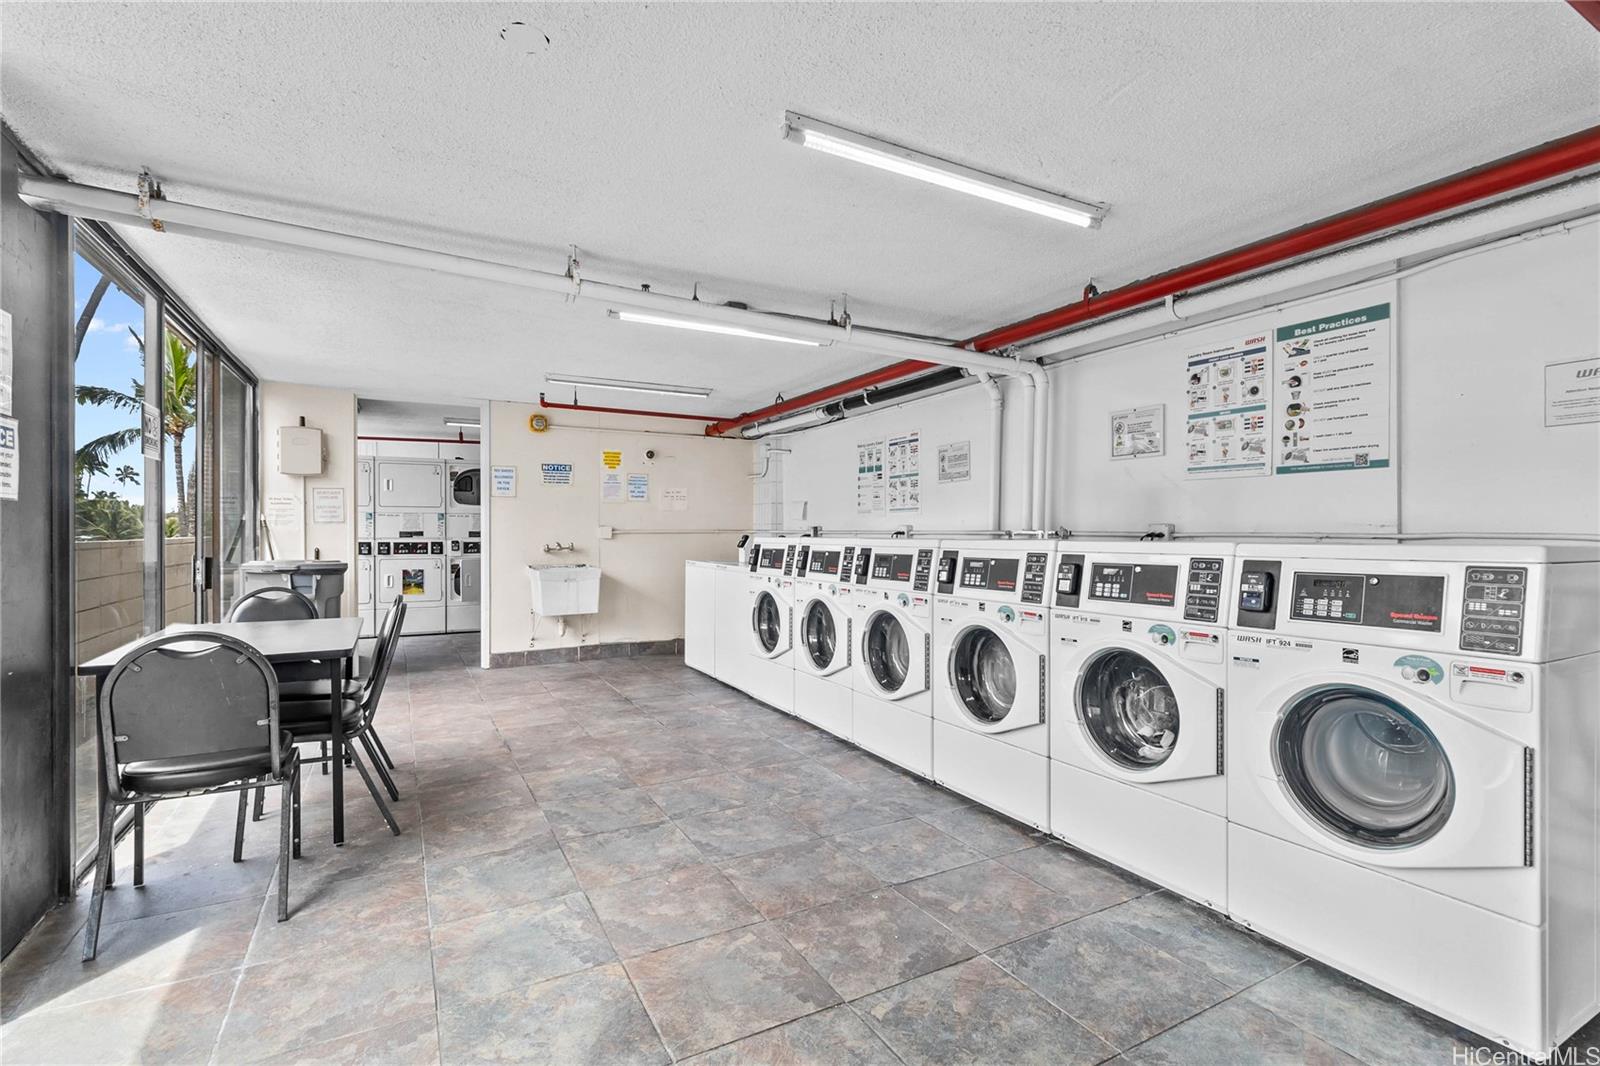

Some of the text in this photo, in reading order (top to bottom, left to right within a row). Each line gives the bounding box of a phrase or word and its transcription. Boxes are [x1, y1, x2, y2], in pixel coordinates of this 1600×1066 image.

[1294, 315, 1367, 336] Best Practices
[1236, 635, 1262, 643] WASH
